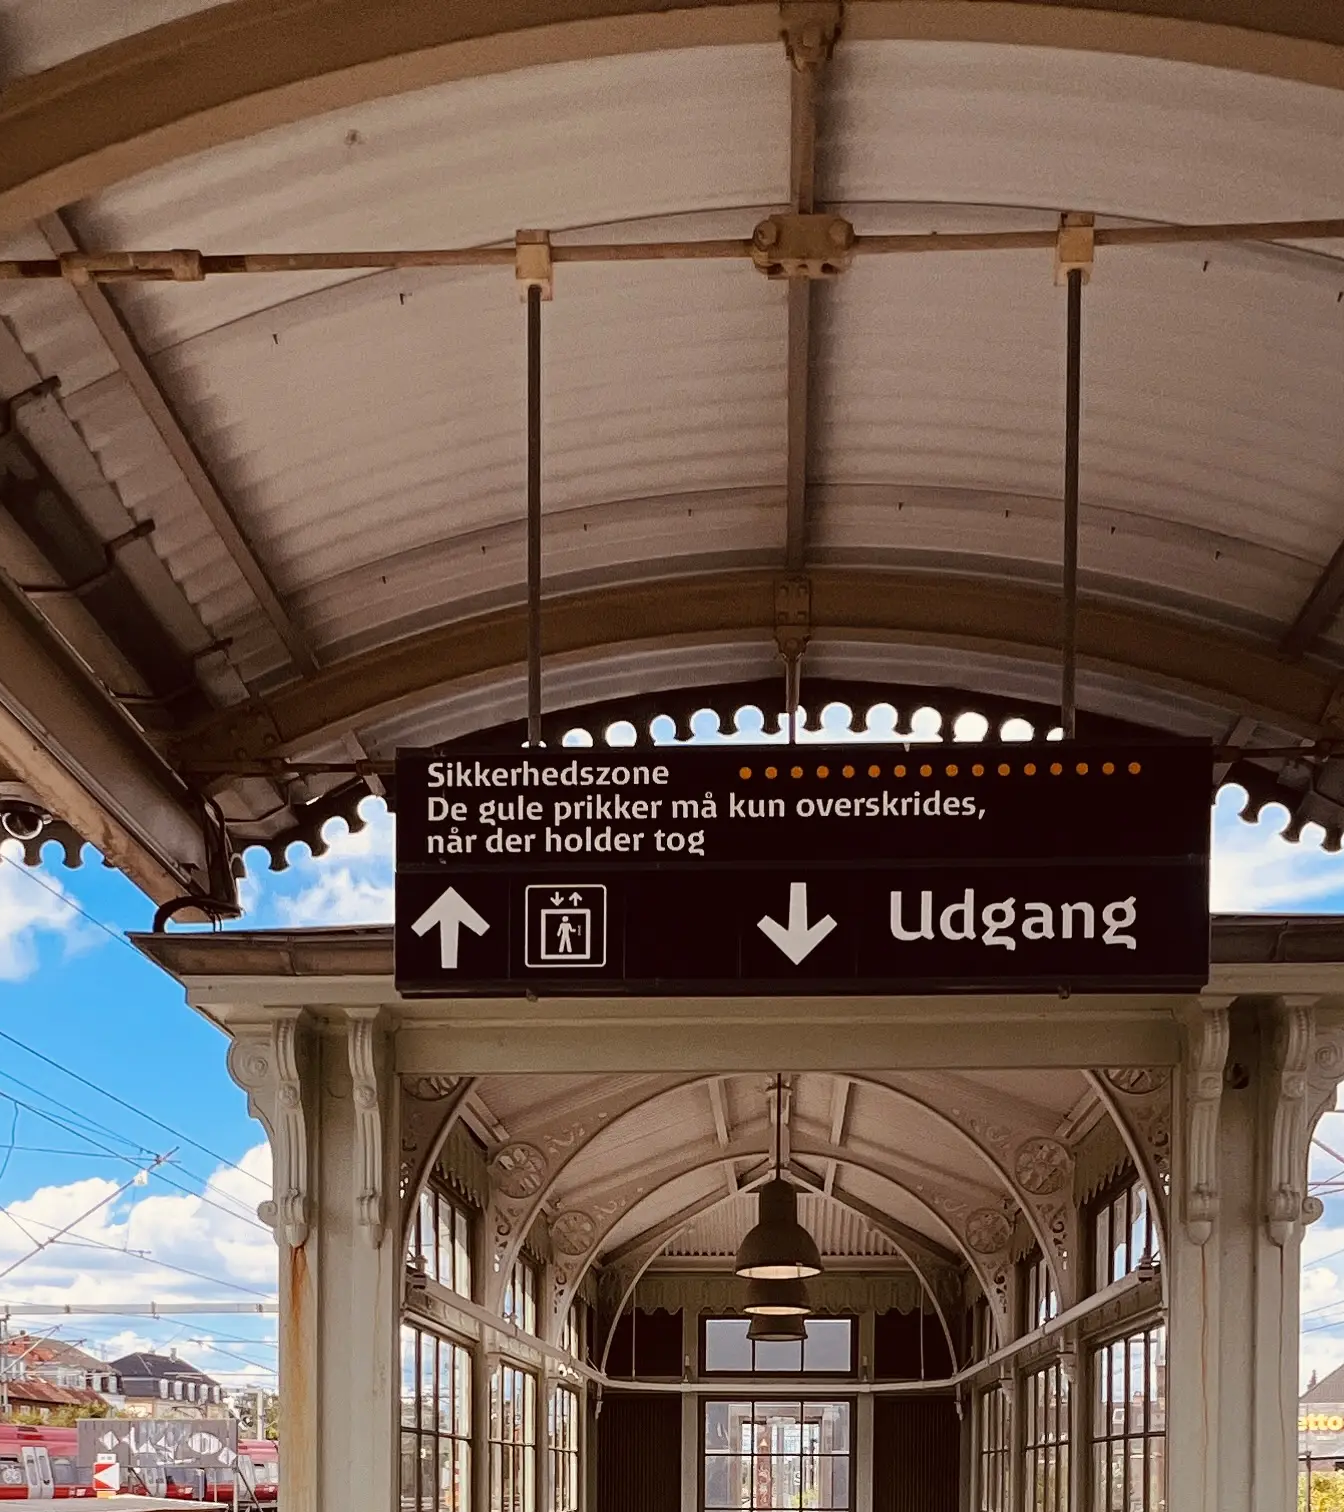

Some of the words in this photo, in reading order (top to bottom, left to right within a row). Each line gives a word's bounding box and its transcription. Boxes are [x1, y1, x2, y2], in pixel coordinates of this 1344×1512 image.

[427, 760, 670, 787] Sikkerhedszone
[428, 797, 468, 822] De
[479, 795, 543, 826] gule
[554, 794, 663, 826] prikker
[671, 792, 718, 819] må
[729, 791, 785, 818] kun
[796, 789, 986, 820] overskrides,
[427, 827, 478, 854] når
[485, 827, 536, 853] der
[545, 826, 645, 853] holder
[653, 829, 705, 857] tog
[890, 888, 1137, 951] Udgang
[1298, 1413, 1344, 1431] etto
